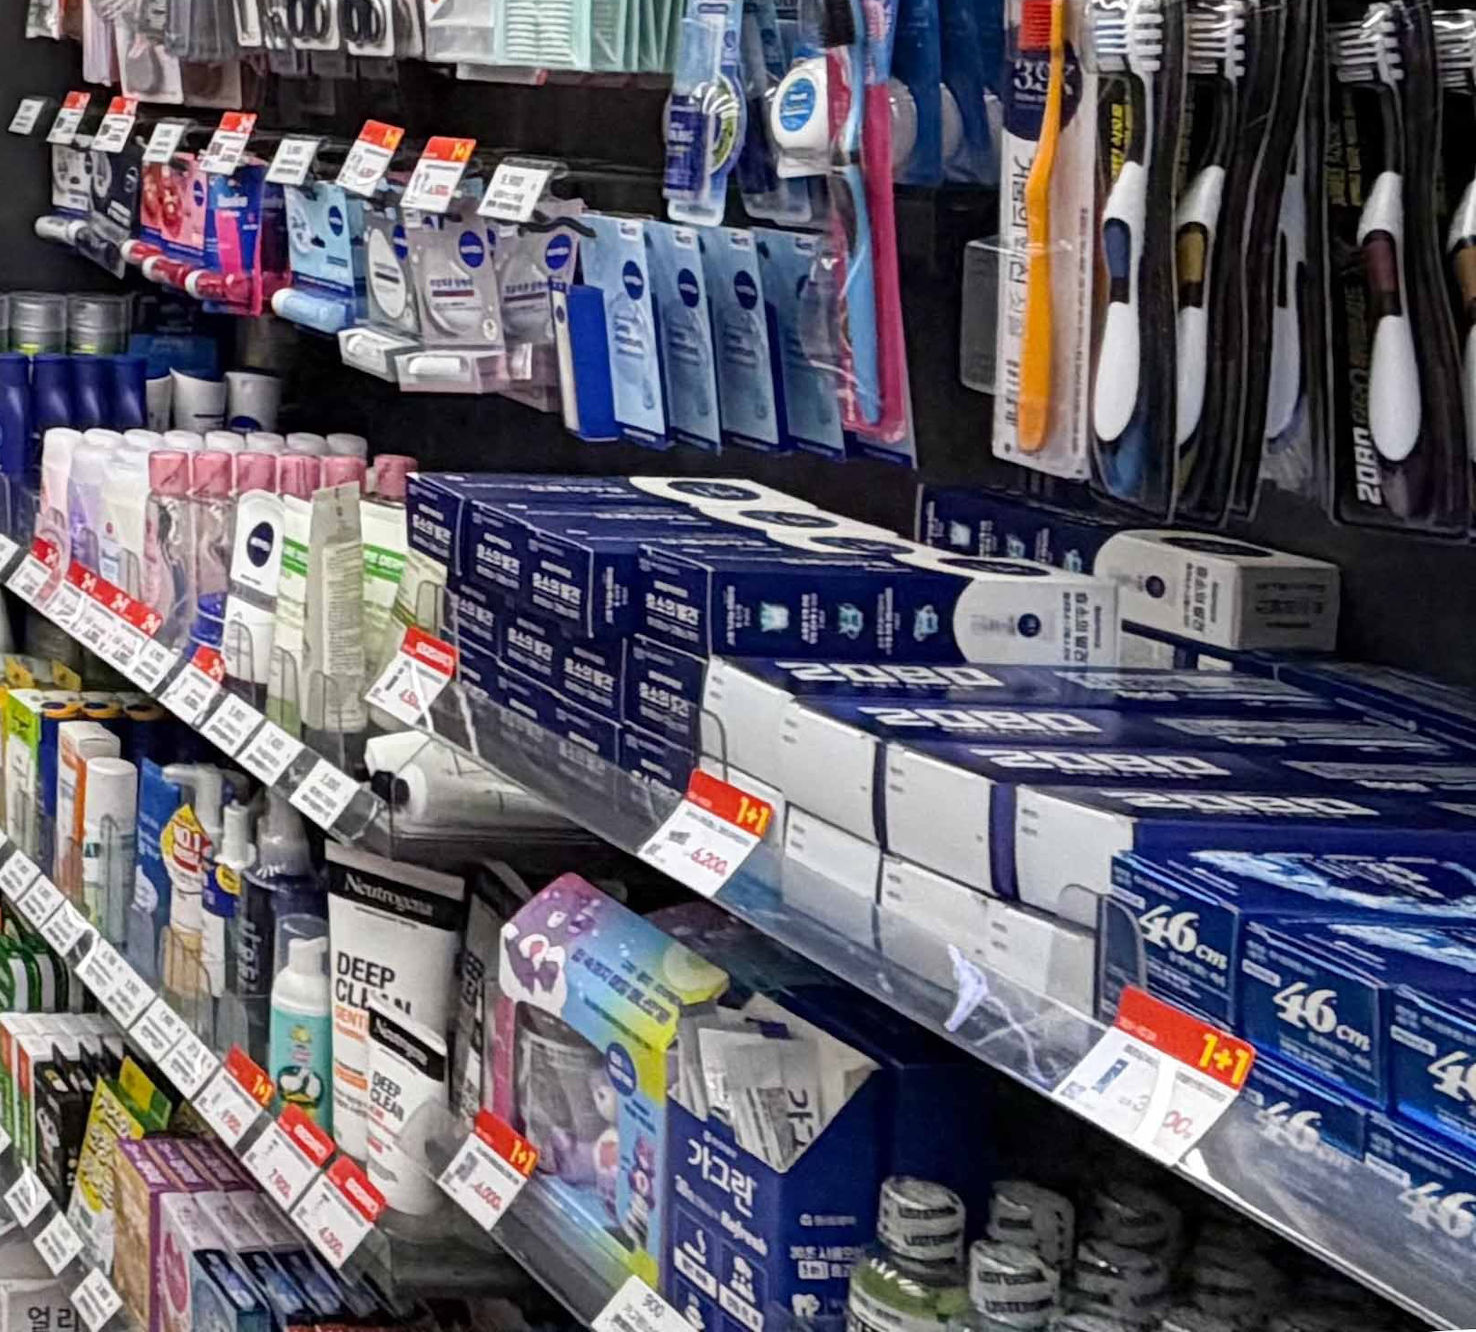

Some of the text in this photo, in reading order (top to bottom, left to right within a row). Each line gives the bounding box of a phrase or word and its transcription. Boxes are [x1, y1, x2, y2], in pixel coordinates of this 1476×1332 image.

[775, 661, 1005, 689] 2080
[857, 706, 1104, 734] 2080
[967, 748, 1232, 777] 2080
[736, 795, 772, 836] 1+1
[1099, 789, 1381, 817] 2080
[344, 872, 435, 918] Neutrogena
[335, 950, 396, 991] DEEP
[1271, 980, 1372, 1054] 46cm
[1198, 1033, 1250, 1087] 1+1
[686, 1138, 758, 1219] 가그린
